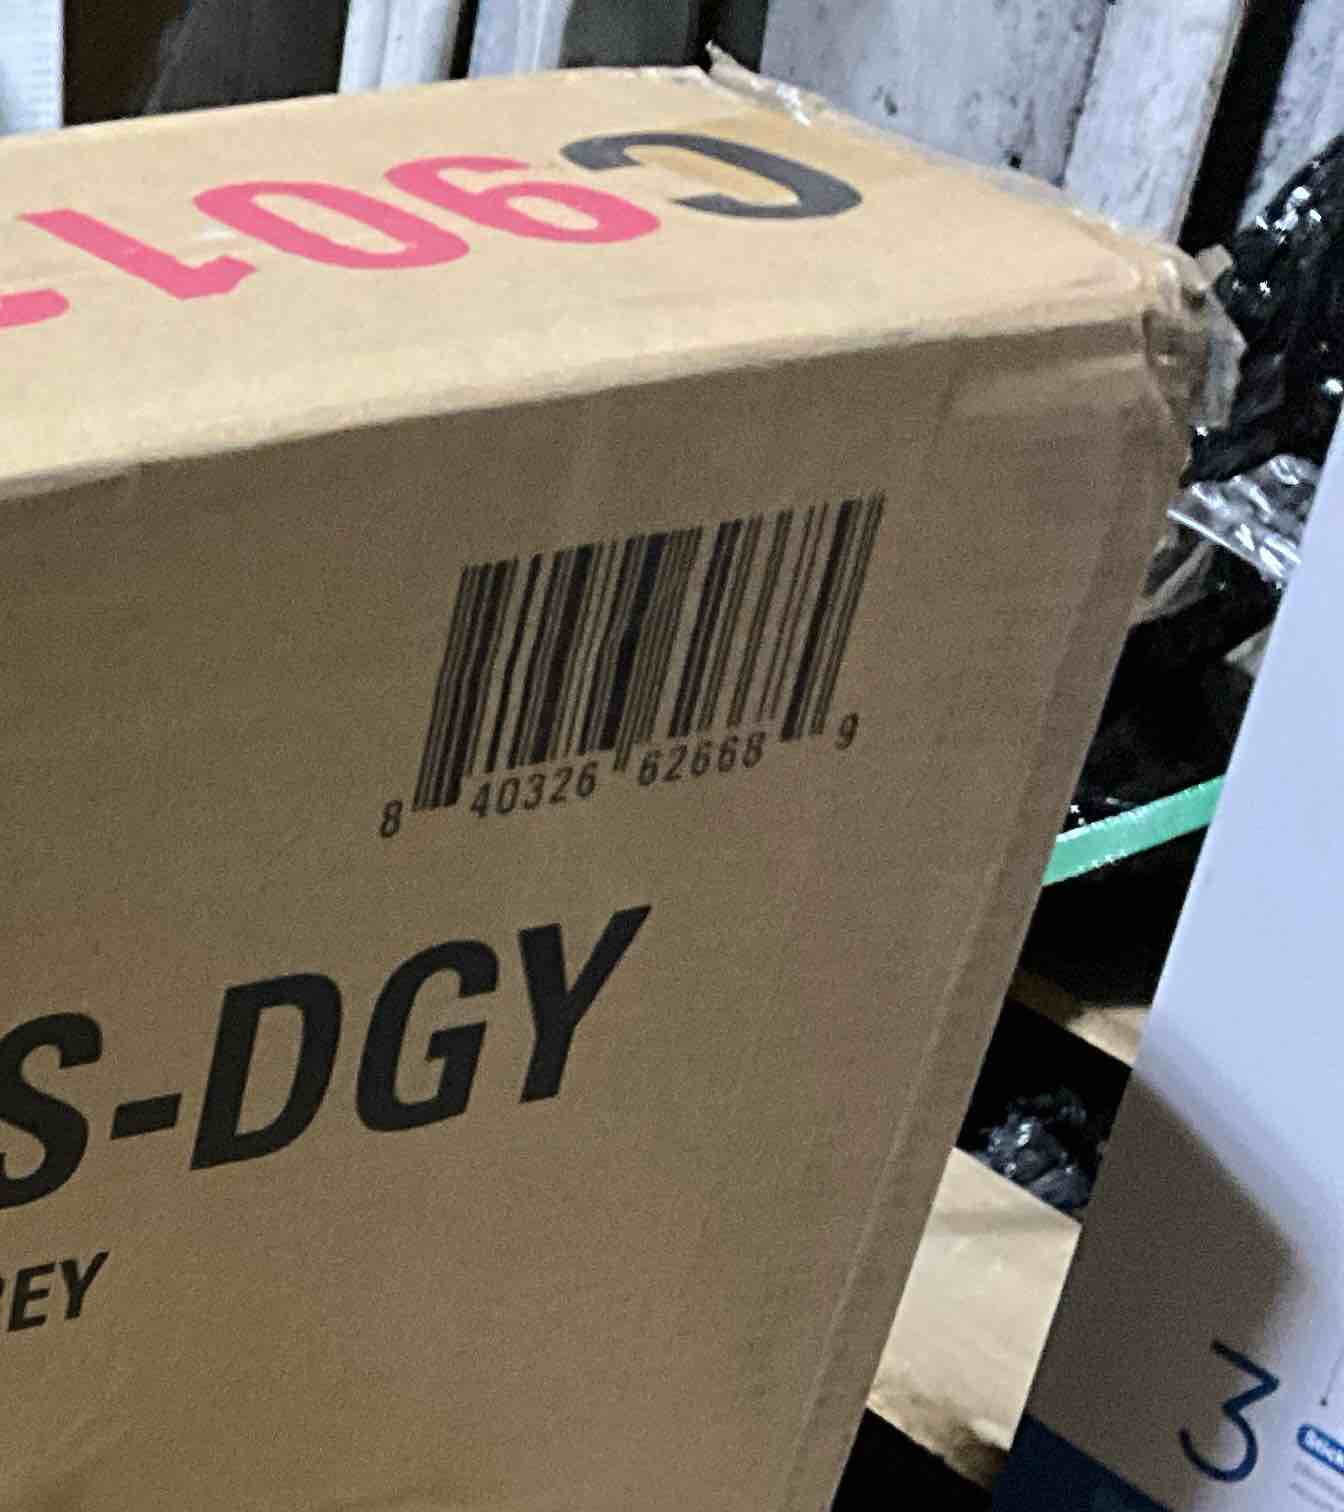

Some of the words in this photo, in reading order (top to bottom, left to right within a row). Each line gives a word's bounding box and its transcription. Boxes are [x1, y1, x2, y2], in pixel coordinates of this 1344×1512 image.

[378, 800, 403, 838] 8
[469, 761, 599, 819] 40326
[638, 730, 768, 787] 62668
[836, 711, 860, 751] 9
[1178, 1338, 1280, 1484] 3
